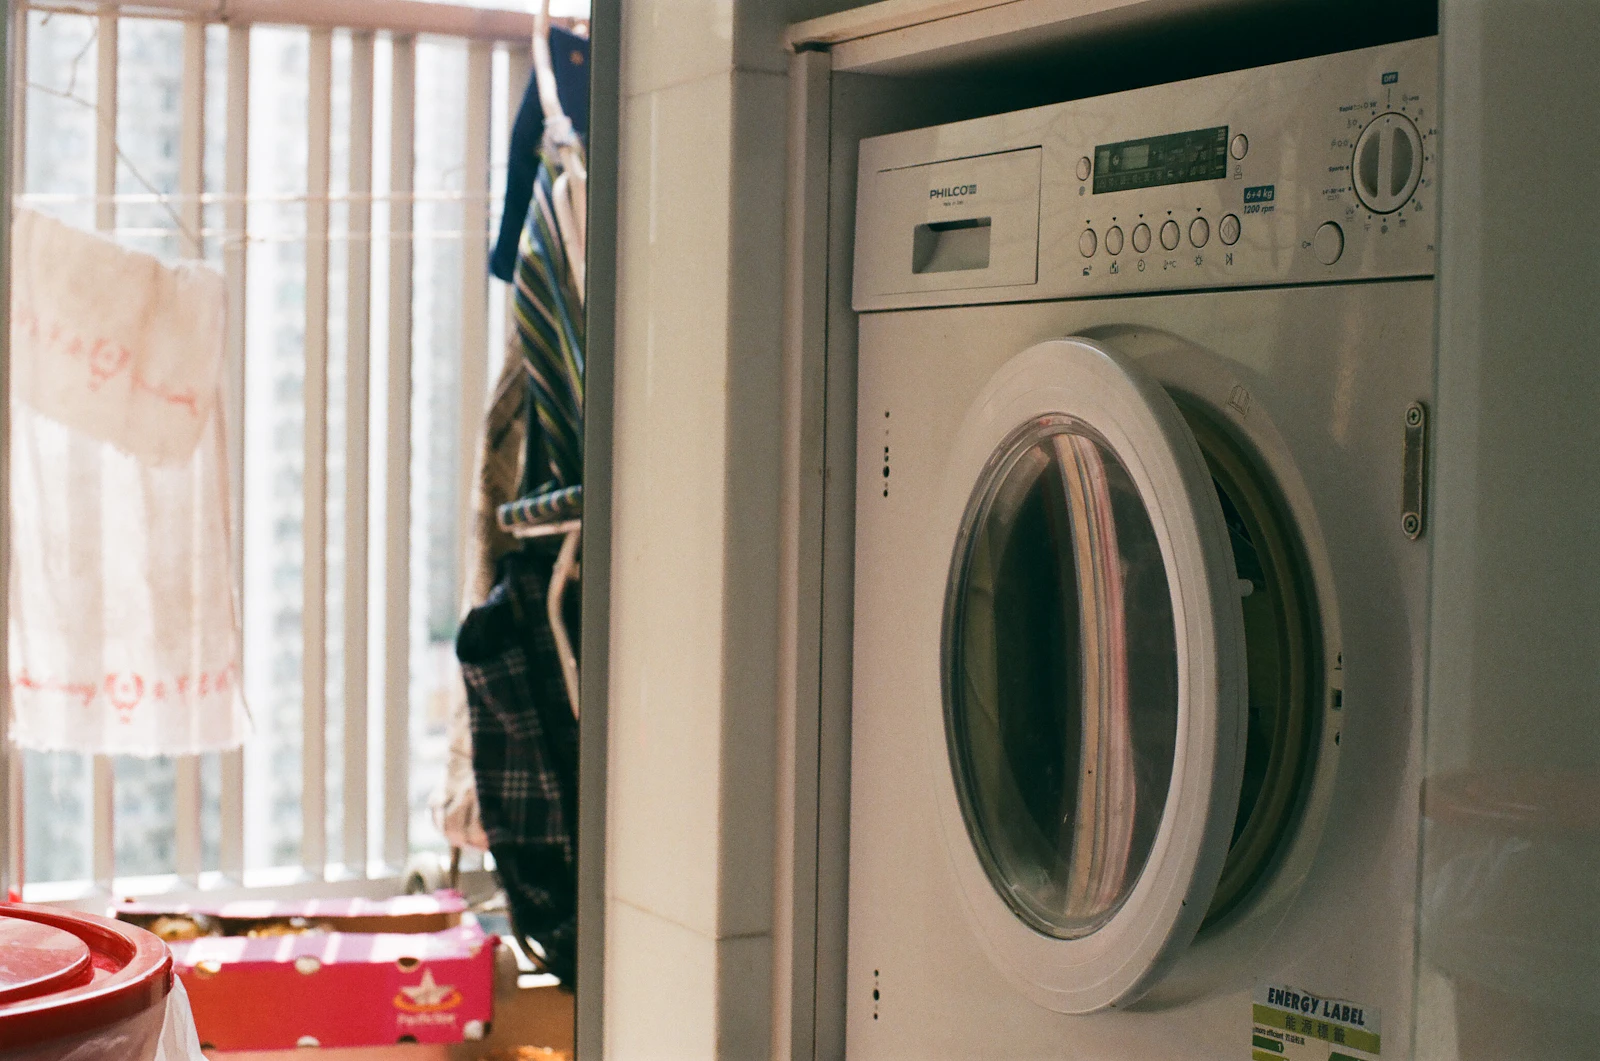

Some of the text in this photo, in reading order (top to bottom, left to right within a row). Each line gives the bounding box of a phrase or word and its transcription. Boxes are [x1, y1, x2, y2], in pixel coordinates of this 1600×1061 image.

[1383, 73, 1397, 83] OFF
[930, 185, 968, 199] PHILCO
[1246, 189, 1273, 199] 6+4 kg
[1243, 204, 1274, 214] 1200 rpm
[1268, 987, 1365, 1025] ENERGY LABEL
